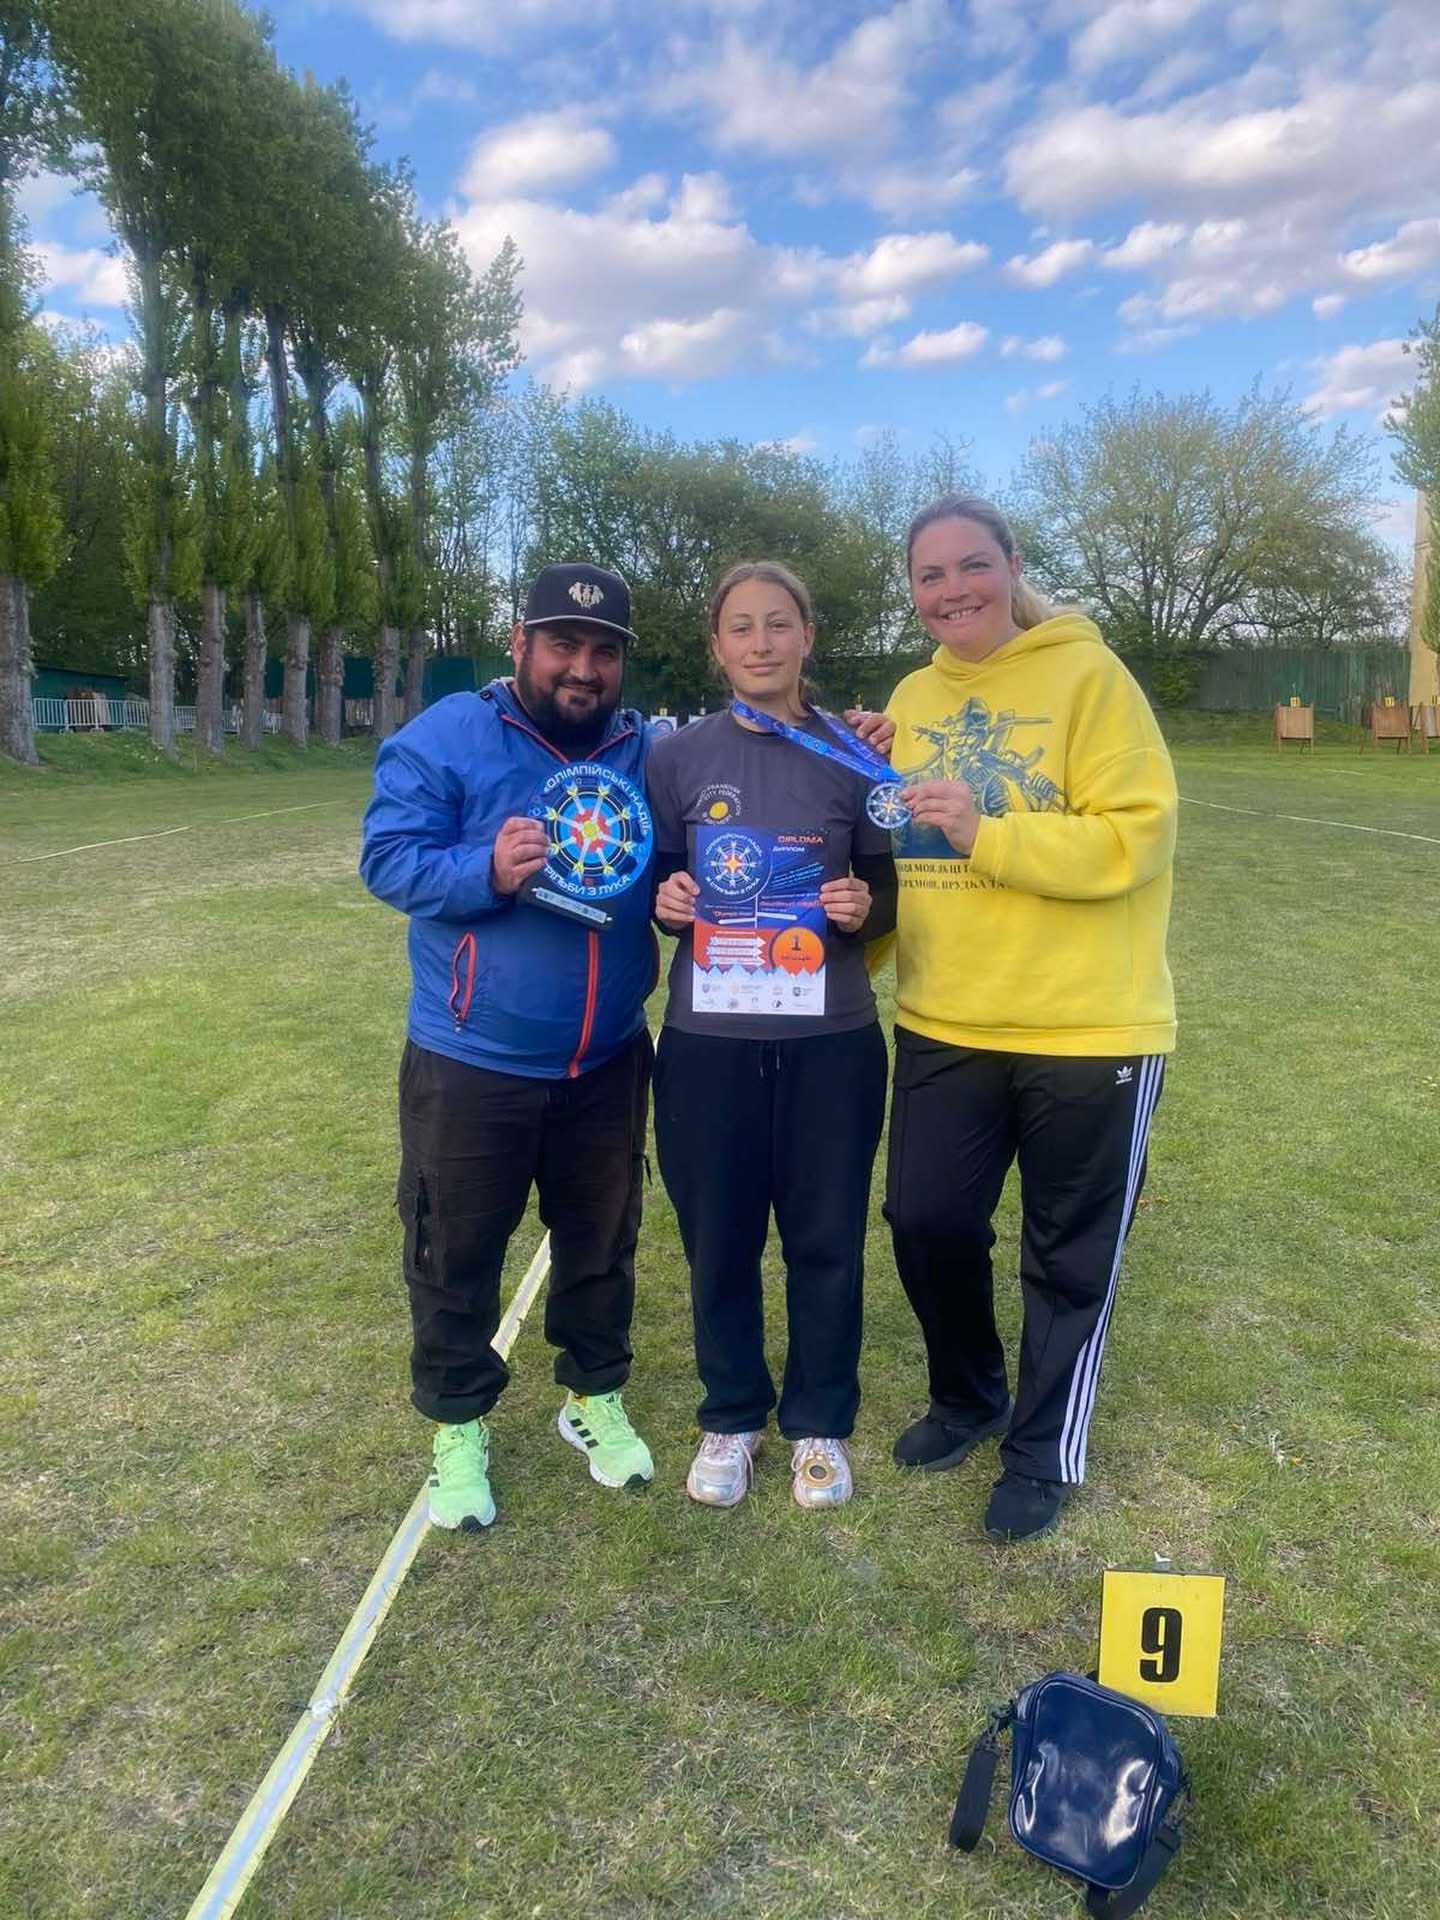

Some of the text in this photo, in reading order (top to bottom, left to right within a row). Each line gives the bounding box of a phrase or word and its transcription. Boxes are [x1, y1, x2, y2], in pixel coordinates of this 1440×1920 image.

[777, 835, 824, 844] DIPLOMA
[791, 935, 801, 951] 1
[1139, 1607, 1183, 1683] 9
